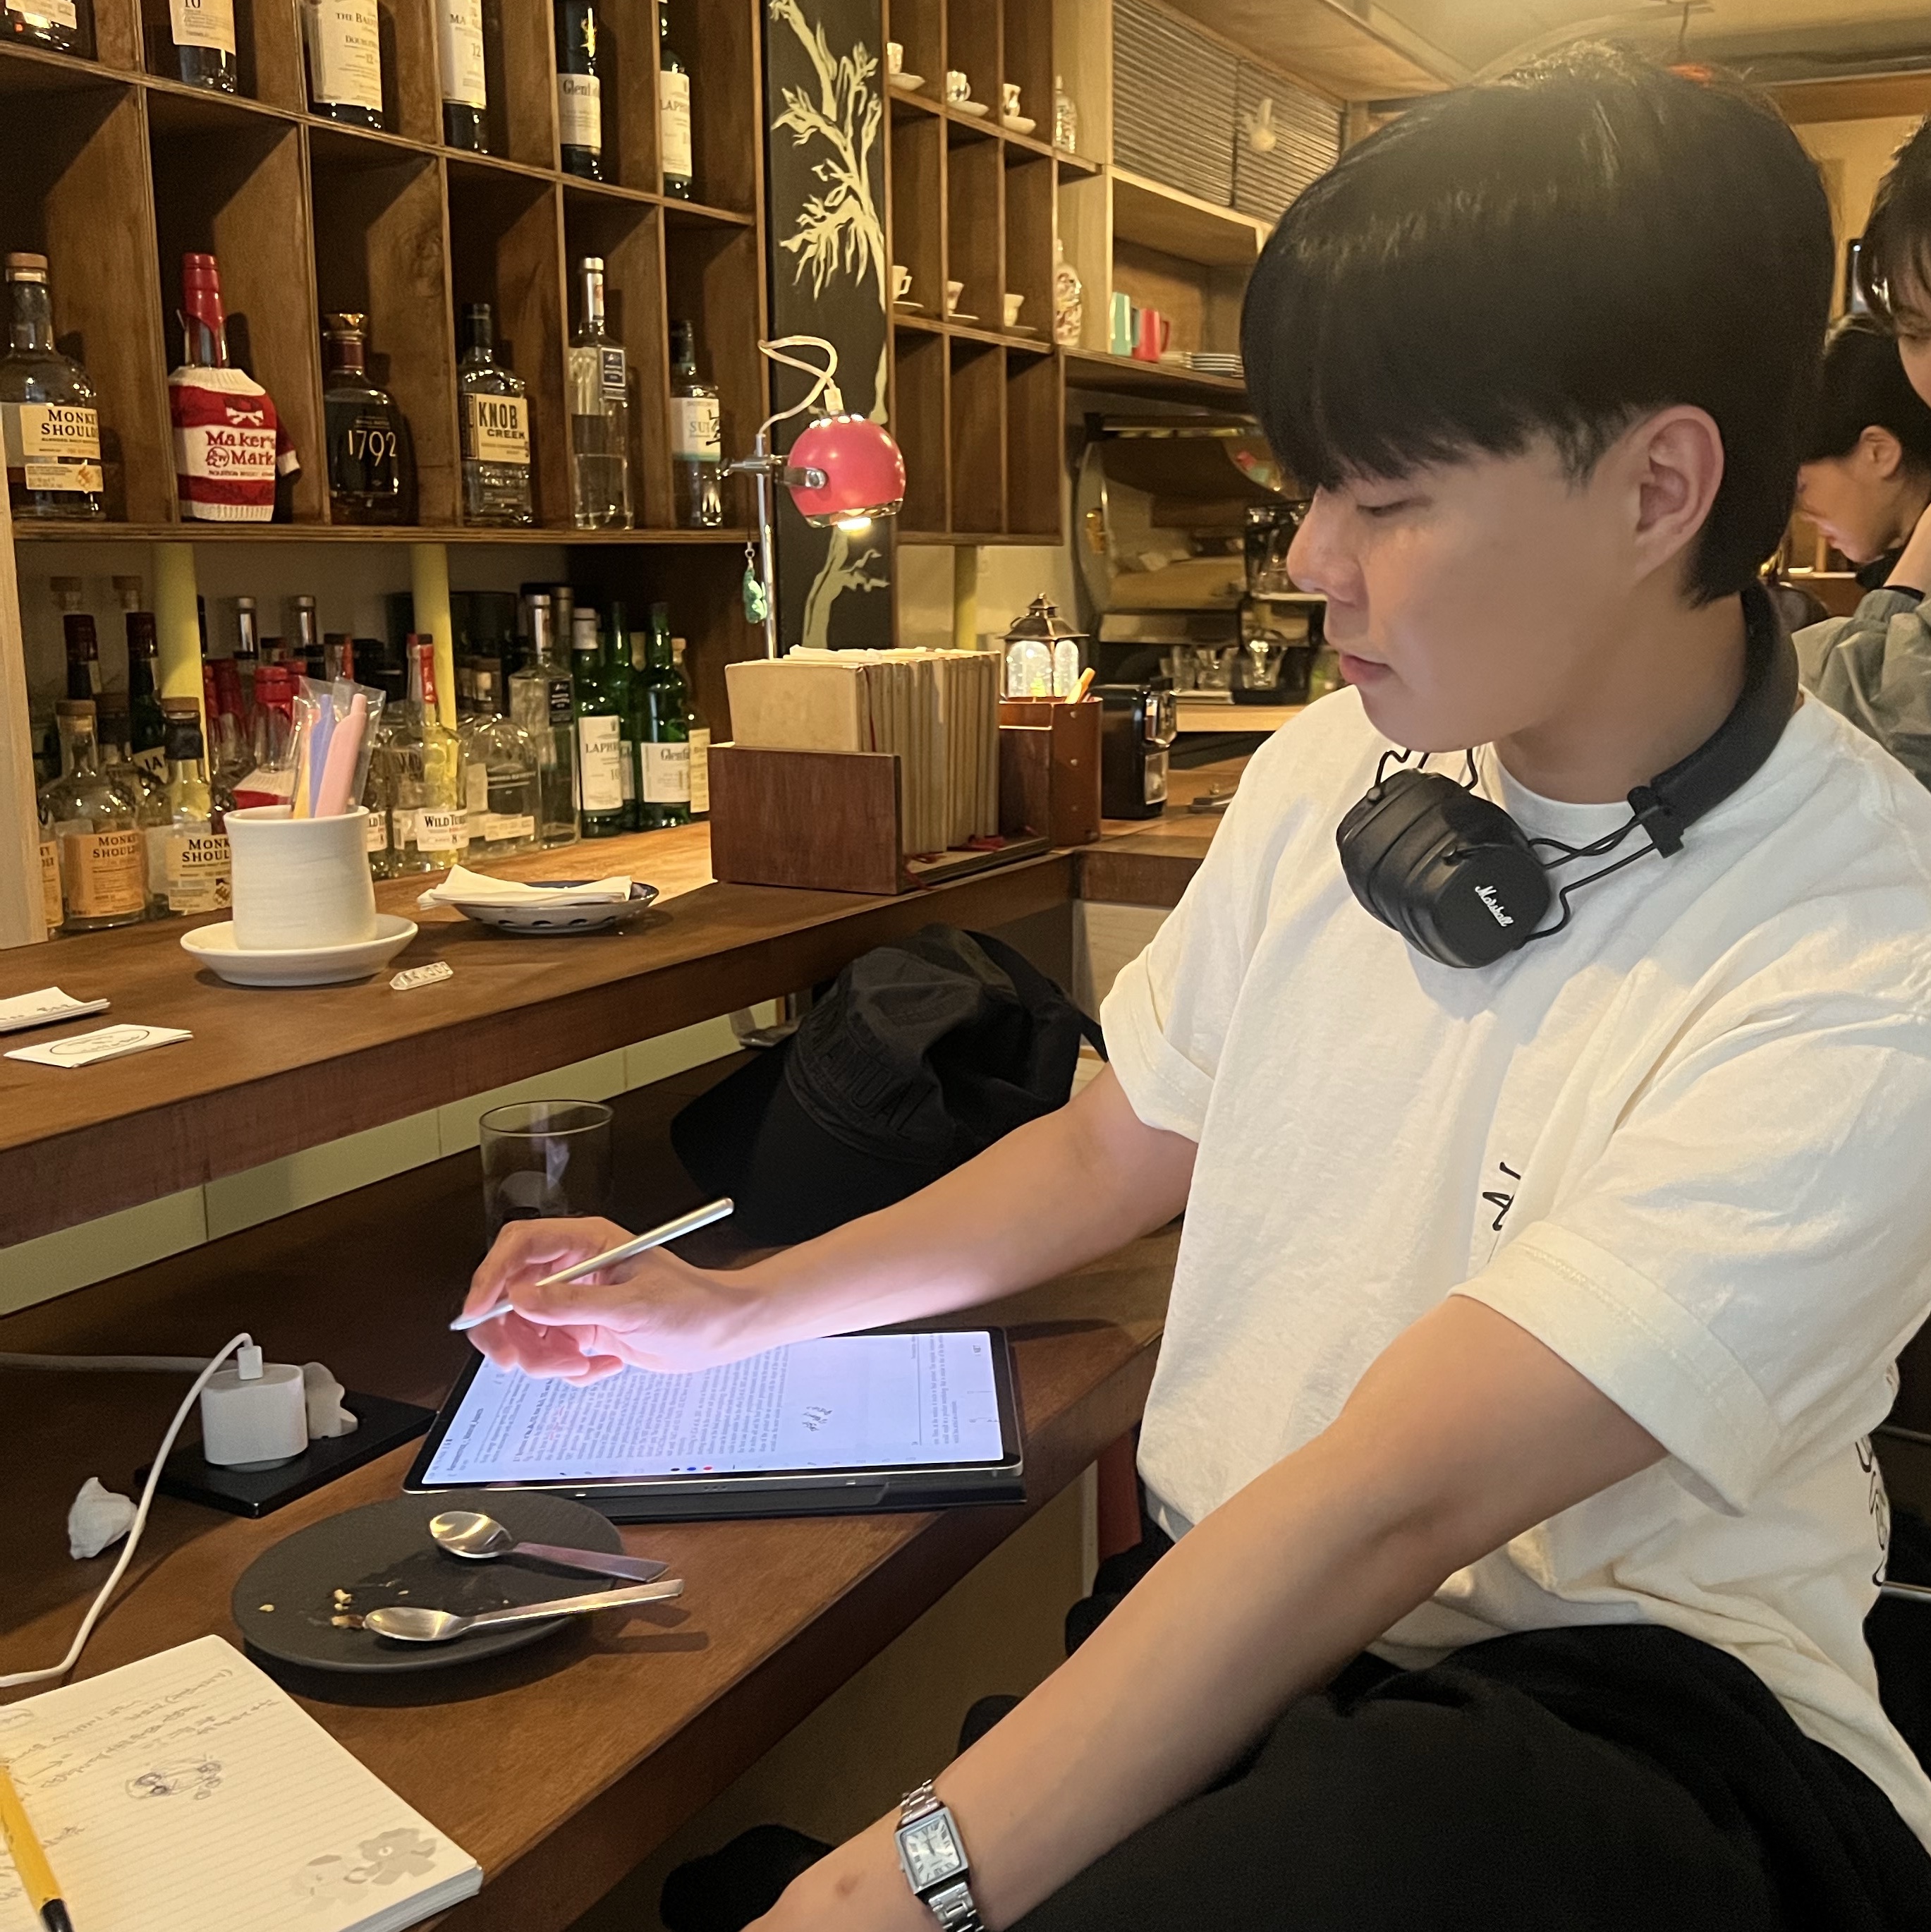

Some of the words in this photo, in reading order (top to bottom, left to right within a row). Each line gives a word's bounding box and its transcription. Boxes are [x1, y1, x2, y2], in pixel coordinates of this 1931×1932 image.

[478, 401, 518, 430] KNOB
[487, 428, 526, 439] CREEK
[348, 430, 396, 467] 1792
[424, 815, 450, 828] WILD
[182, 849, 230, 862] SHOUL
[1475, 885, 1514, 928] Marshall
